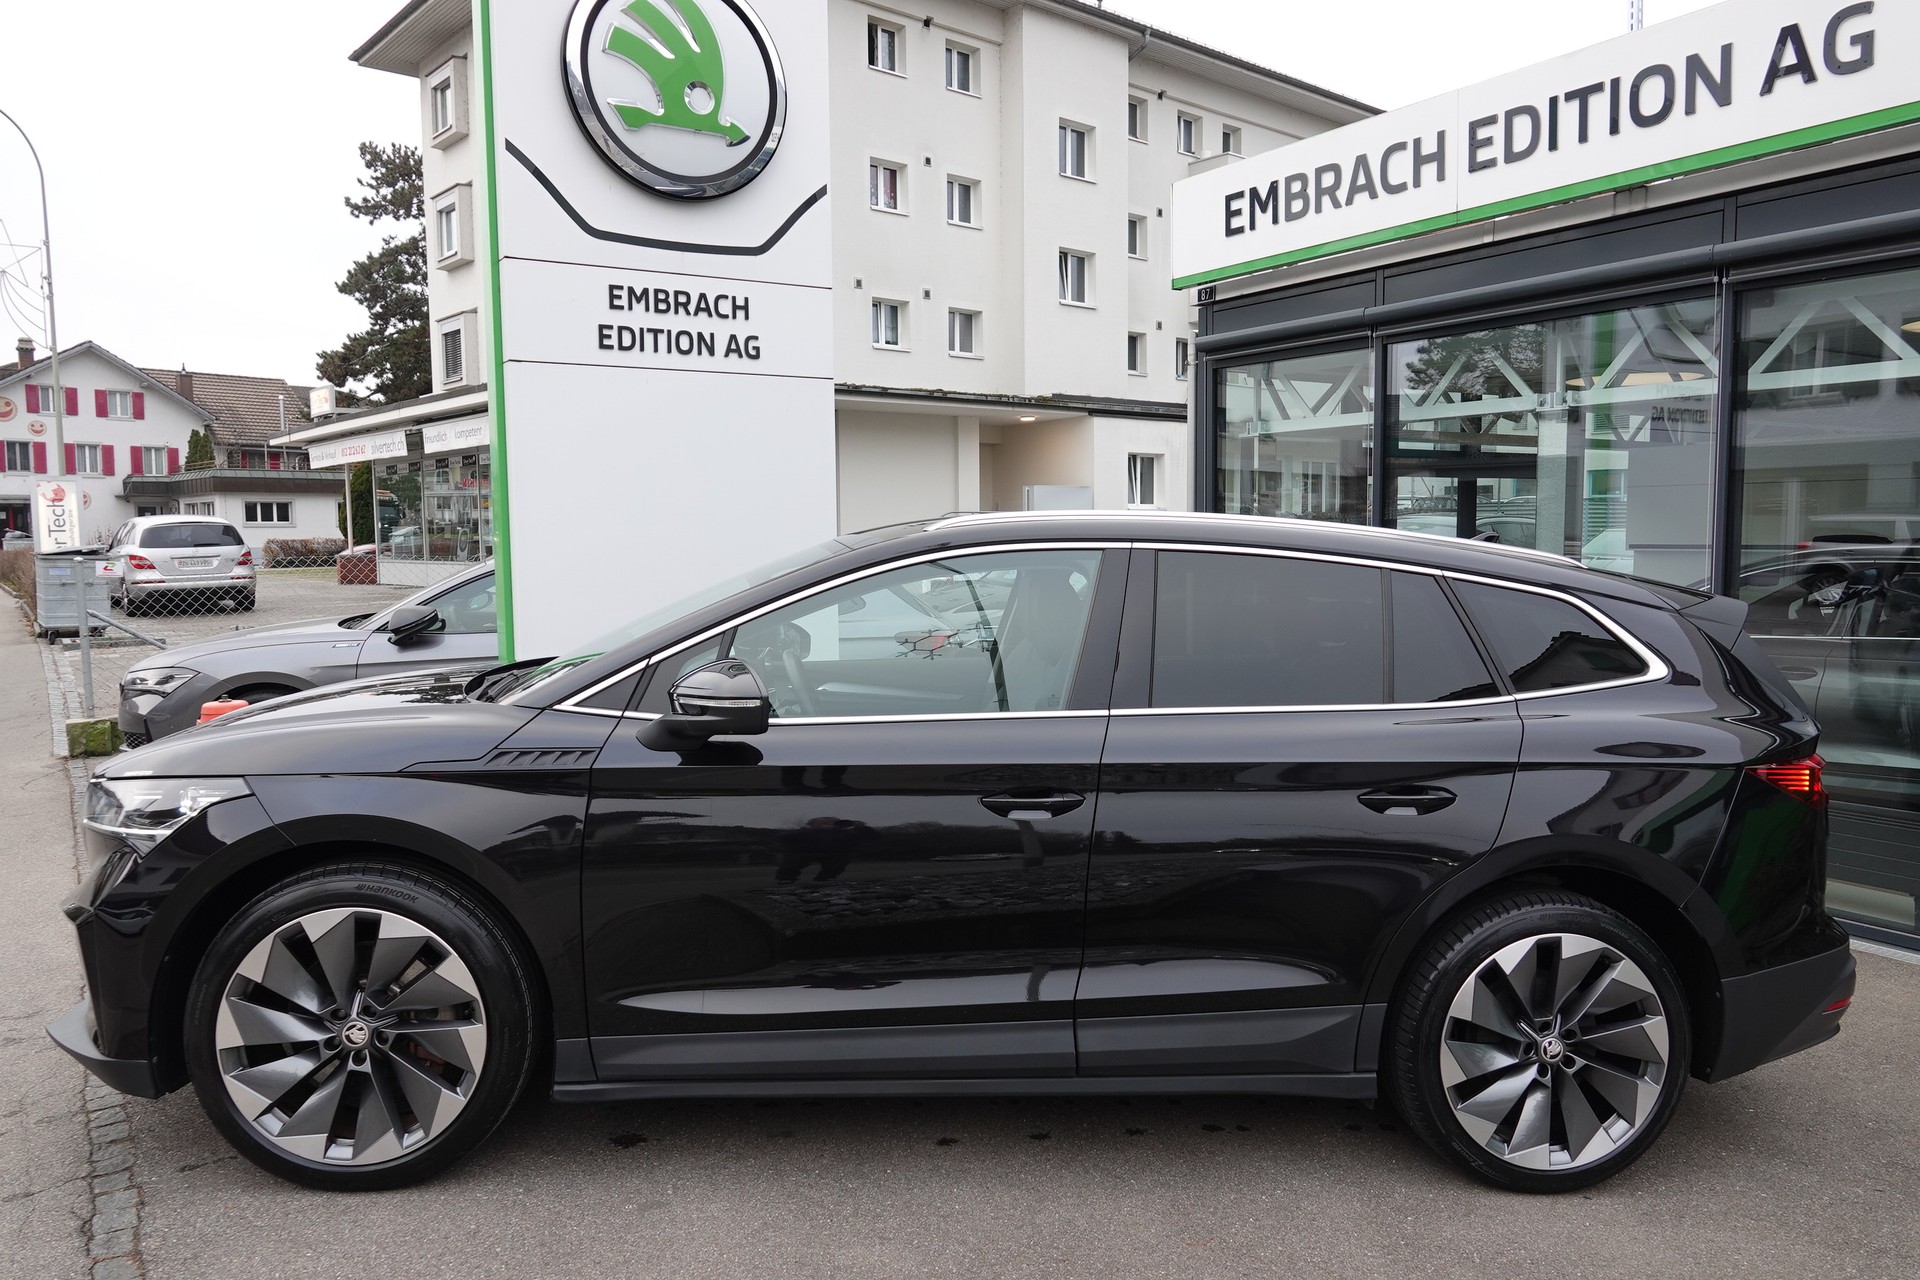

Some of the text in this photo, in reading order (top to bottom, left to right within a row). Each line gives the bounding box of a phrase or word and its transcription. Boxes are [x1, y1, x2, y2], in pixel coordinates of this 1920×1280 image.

[1225, 0, 1876, 236] EMBRACH EDITION AG
[608, 284, 750, 321] EMBRACH
[1201, 288, 1211, 300] 87
[598, 324, 761, 360] EDITION AG
[371, 436, 405, 455] silvertech.ch
[454, 427, 483, 440] kompetent
